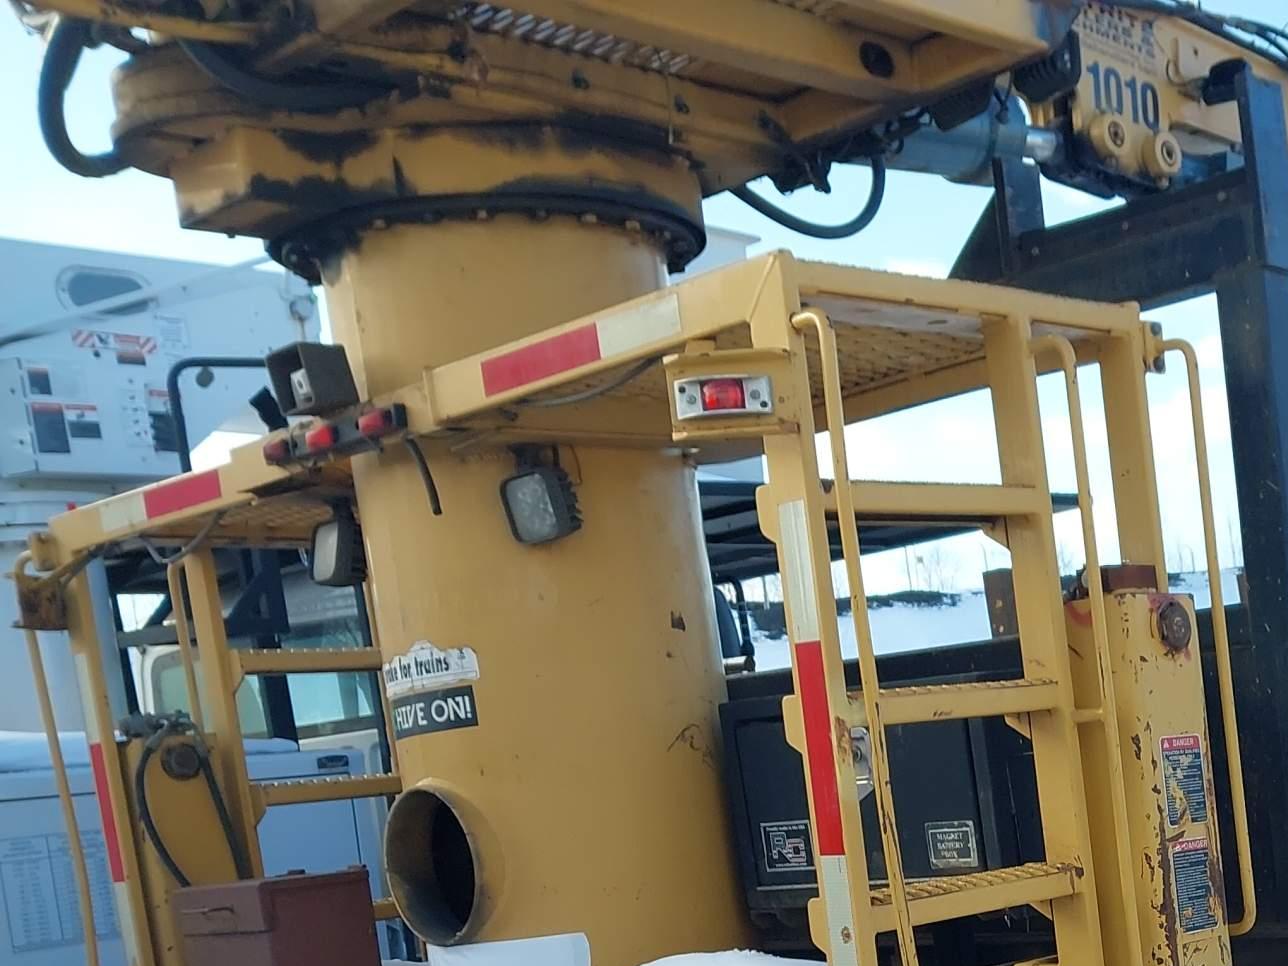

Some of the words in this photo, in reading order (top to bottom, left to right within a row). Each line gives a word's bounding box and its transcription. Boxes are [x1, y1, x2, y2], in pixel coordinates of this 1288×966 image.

[1086, 62, 1160, 134] 1010
[399, 656, 412, 680] for
[414, 649, 450, 677] trains
[431, 695, 472, 723] ON!
[1172, 737, 1194, 747] DANGER
[936, 832, 963, 841] MAGNET
[937, 841, 964, 850] BATTERY
[1184, 839, 1208, 850] DANGER
